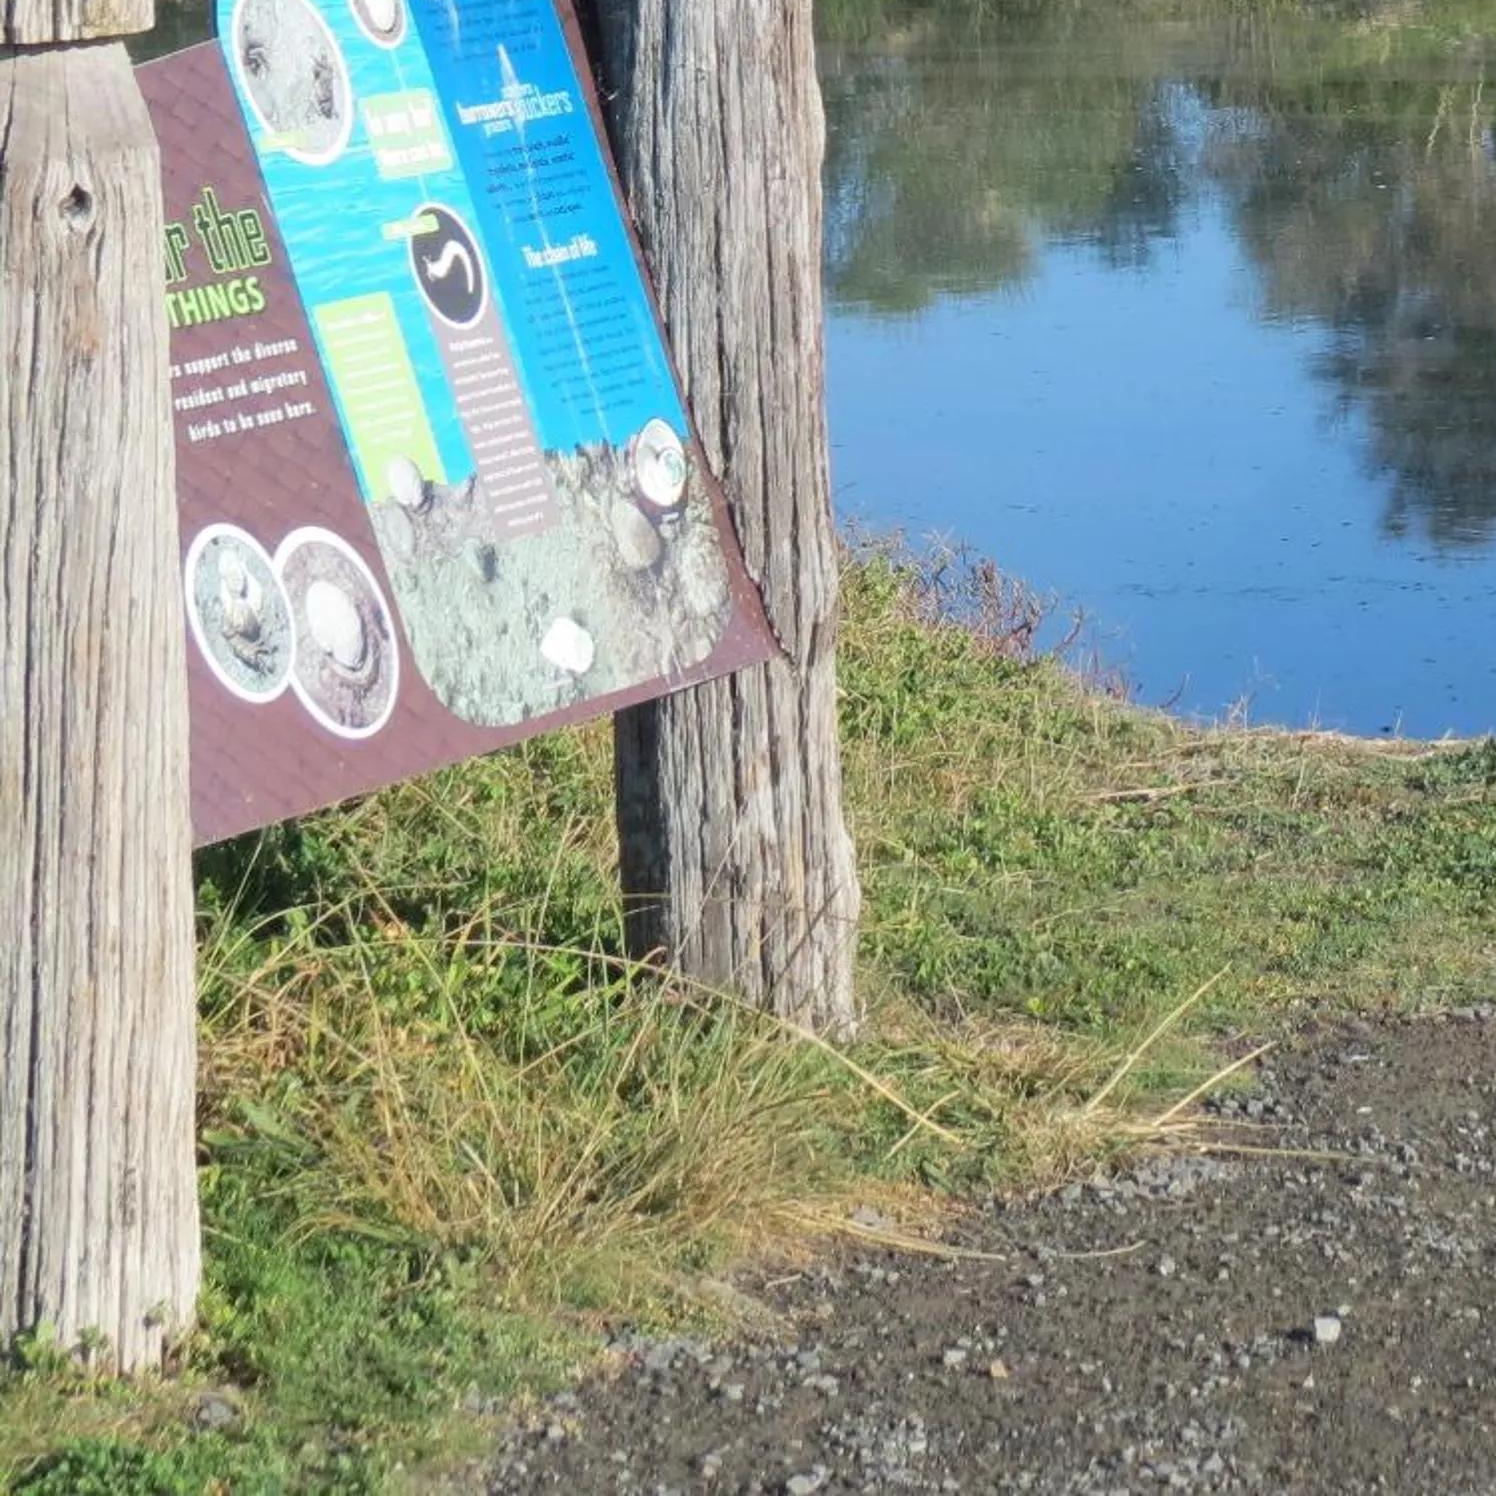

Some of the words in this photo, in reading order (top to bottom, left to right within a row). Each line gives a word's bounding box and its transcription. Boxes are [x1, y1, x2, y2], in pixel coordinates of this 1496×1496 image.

[192, 186, 272, 274] the
[165, 275, 266, 329] THINGS
[184, 352, 230, 375] support
[231, 345, 252, 365] the
[254, 338, 298, 360] diverse
[174, 386, 225, 412] resident
[226, 378, 248, 400] and
[250, 369, 307, 394] migratory
[188, 420, 221, 442] birds
[223, 417, 237, 434] to
[238, 412, 254, 430] be
[256, 408, 283, 426] seen
[284, 401, 317, 420] here.
